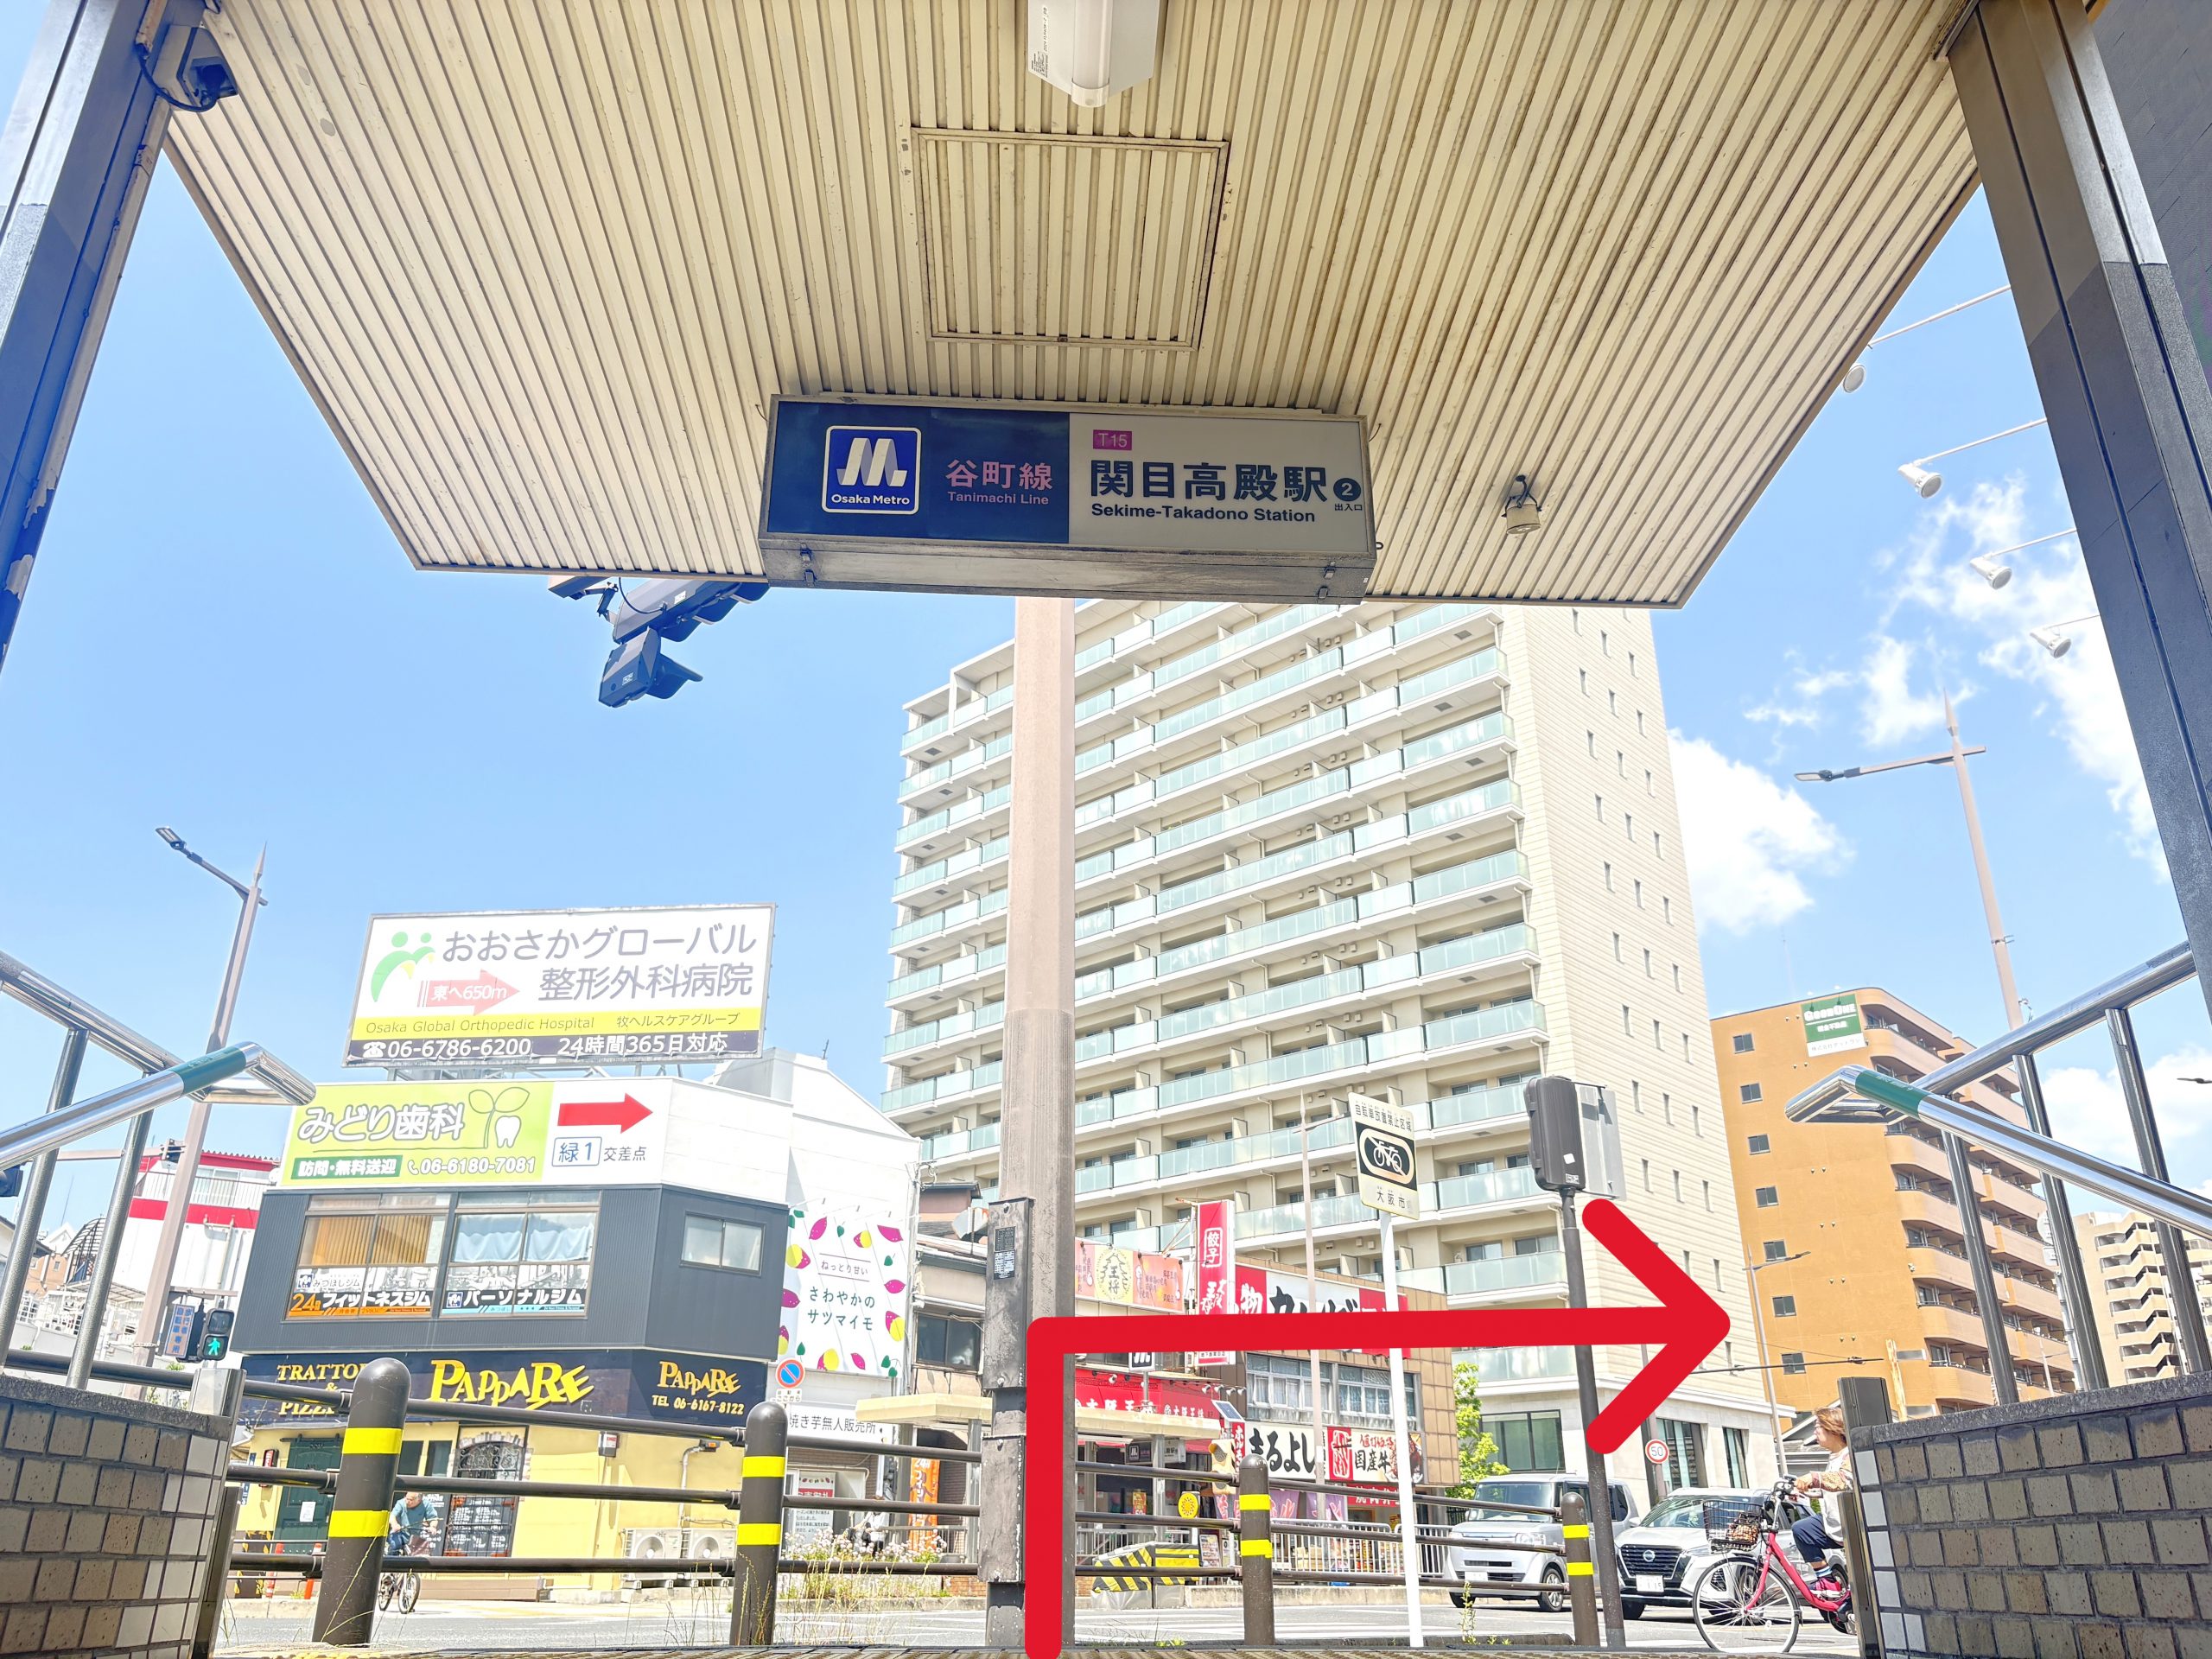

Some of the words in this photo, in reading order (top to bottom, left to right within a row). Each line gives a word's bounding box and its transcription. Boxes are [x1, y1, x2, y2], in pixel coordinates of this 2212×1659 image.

[1097, 432, 1128, 448] T15
[945, 459, 1053, 491] 谷町線
[1090, 460, 1327, 502] 関目高殿駅
[831, 493, 871, 505] Osaka
[873, 495, 910, 505] Metro
[947, 491, 1016, 504] Tanimachi
[1020, 493, 1049, 505] Line
[1334, 503, 1363, 512] 出入口
[1091, 503, 1249, 521] Sekime-Takadono
[1254, 508, 1315, 522] Station
[442, 923, 757, 962] おおさかグローバル
[538, 962, 753, 1001] 整形外科病院
[432, 985, 507, 1001] 東へ650m
[366, 1022, 407, 1033] Osaka
[413, 1020, 455, 1033] Global
[461, 1019, 535, 1033] Orthopedic
[539, 1017, 594, 1031] Hospital
[616, 1012, 741, 1028] 牧ヘルスケアグループ
[387, 1038, 531, 1058] 06-6786-6200
[557, 1032, 728, 1056] 24時間365日対応
[298, 1102, 465, 1143] みどり歯科
[603, 1146, 647, 1161] 交差点
[419, 1156, 536, 1175] 06-6180-7081
[1376, 1192, 1406, 1208] 大阪市
[1206, 1231, 1220, 1262] 餃子
[821, 1260, 868, 1275] ねっとり甘い
[1109, 1265, 1120, 1294] 王将
[322, 1290, 431, 1309] フィットネスジム
[463, 1288, 582, 1306] パーソナルジム
[810, 1286, 876, 1309] さわやかの
[807, 1309, 874, 1332] サツマイモ
[277, 1363, 368, 1381] TRATTO
[652, 1395, 670, 1408] TEL
[673, 1399, 745, 1415] 06-6167-8122
[789, 1414, 876, 1434] 焼き芋無人販売所
[1249, 1428, 1316, 1473] まるよし
[1651, 1446, 1663, 1456] 50
[1355, 1449, 1390, 1472] 国産牛
